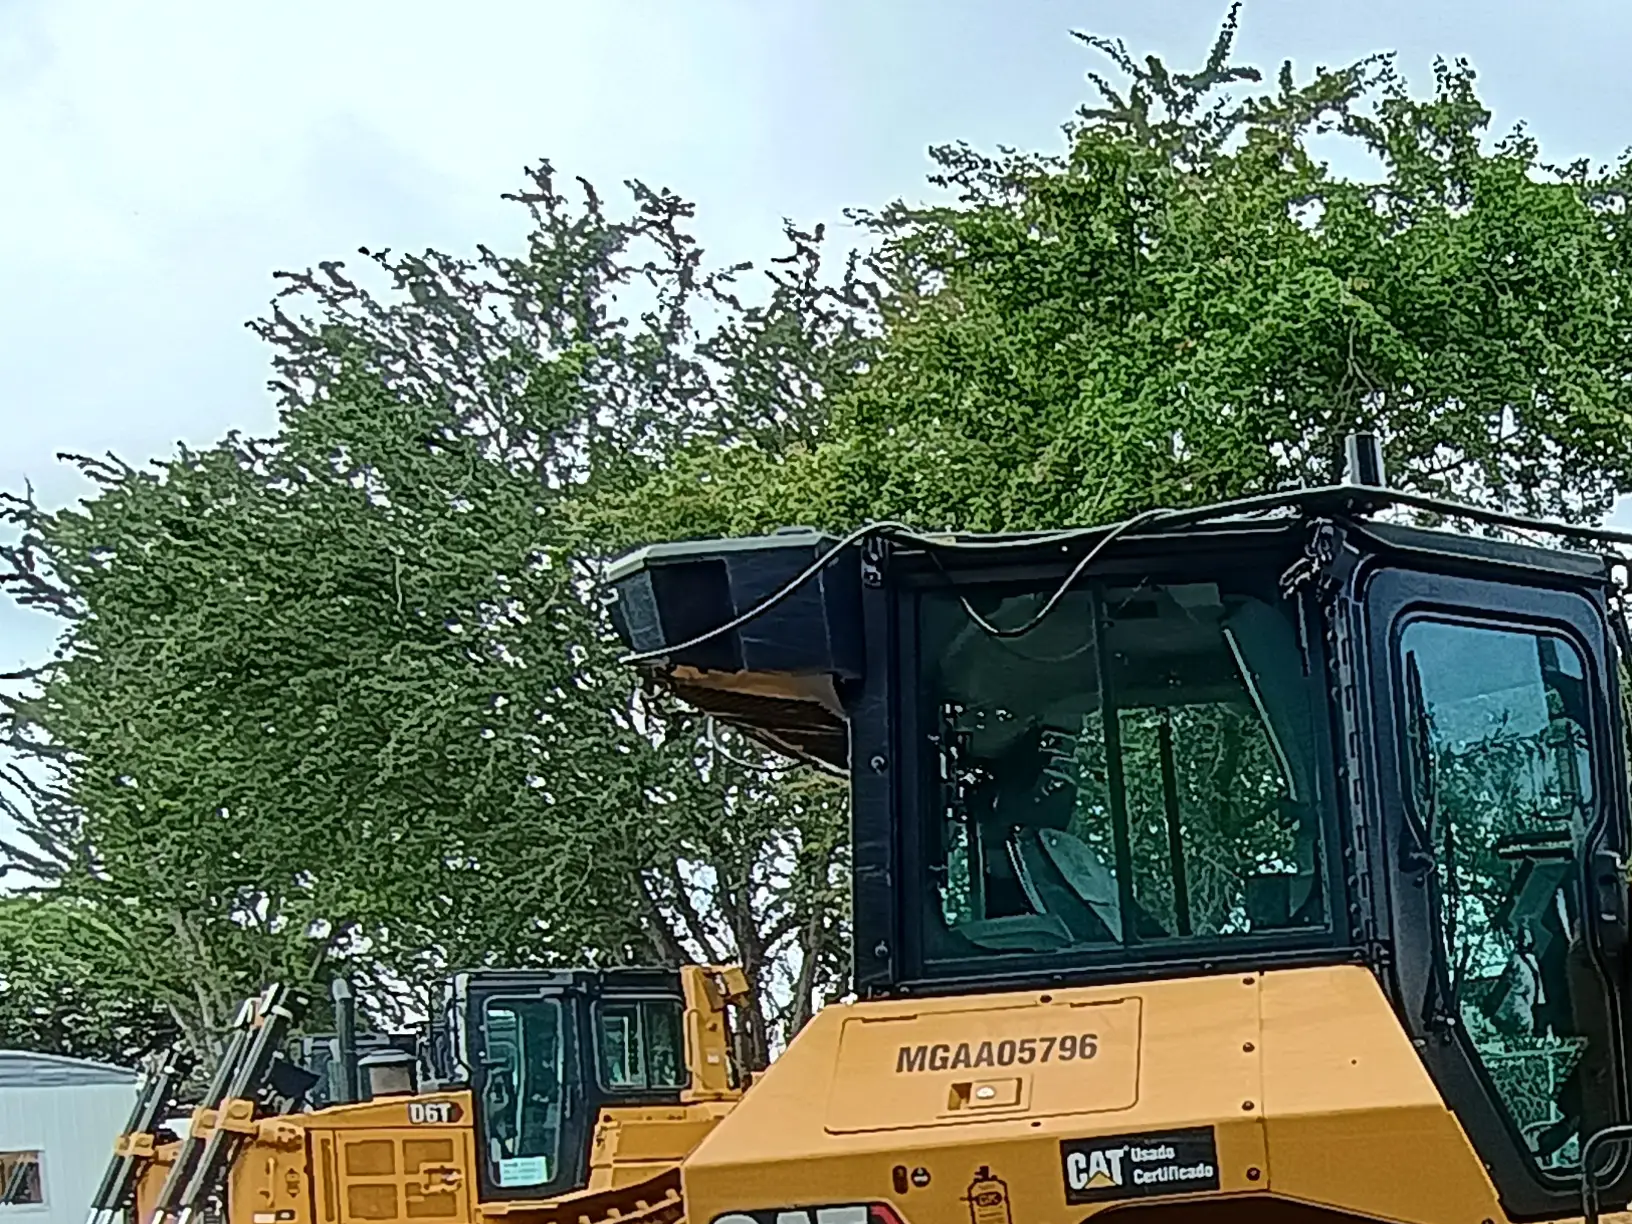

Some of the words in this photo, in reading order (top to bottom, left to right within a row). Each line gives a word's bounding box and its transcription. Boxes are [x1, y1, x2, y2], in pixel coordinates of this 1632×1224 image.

[895, 1033, 1098, 1073] MGAA05796
[409, 1102, 452, 1123] D6T
[1131, 1145, 1176, 1167] Usado
[1066, 1148, 1125, 1190] CAT
[1133, 1163, 1214, 1185] Certificado
